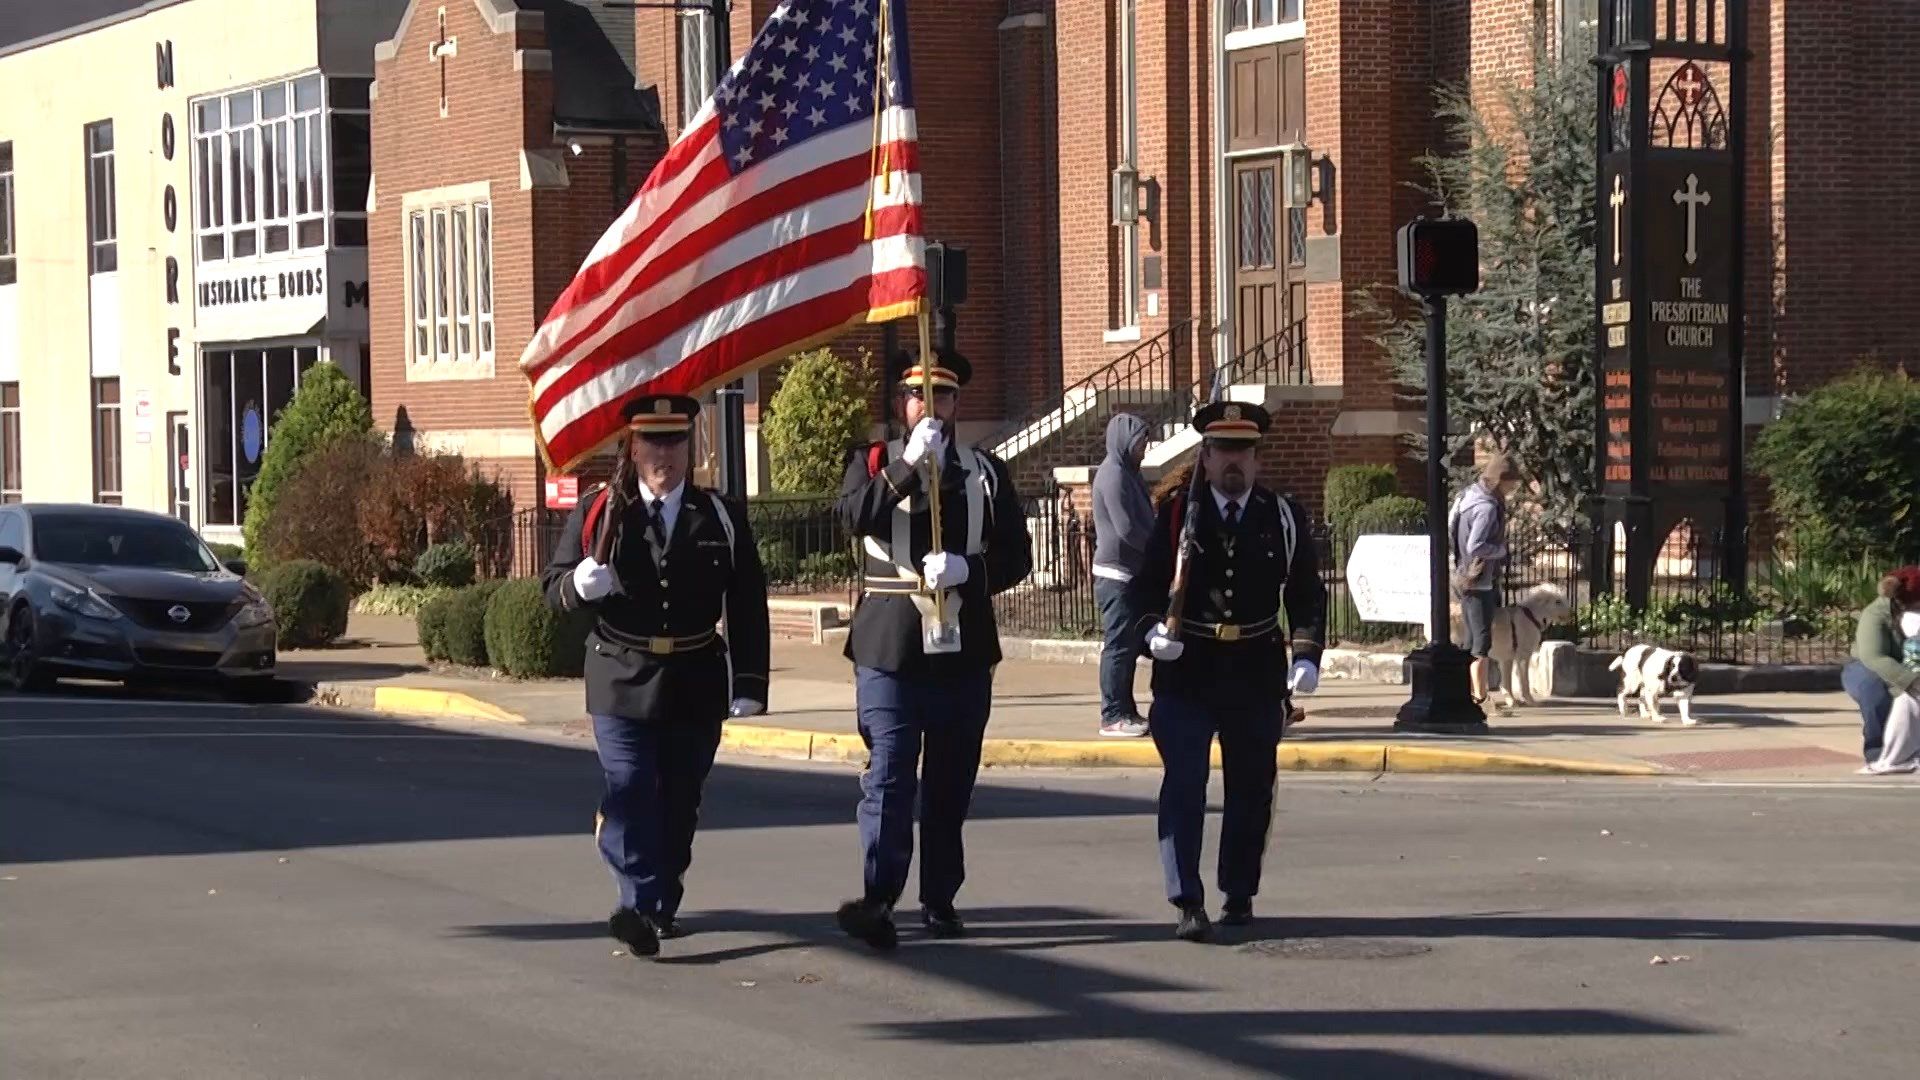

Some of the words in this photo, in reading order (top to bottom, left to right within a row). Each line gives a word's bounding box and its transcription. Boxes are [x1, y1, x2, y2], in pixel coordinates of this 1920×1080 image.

[156, 40, 181, 376] MOORE
[199, 275, 267, 307] INSURANCE
[278, 267, 322, 298] BONDS
[1680, 277, 1701, 298] THE
[1651, 301, 1728, 323] PRESBYTERIAN
[1667, 325, 1713, 347] CHURCH
